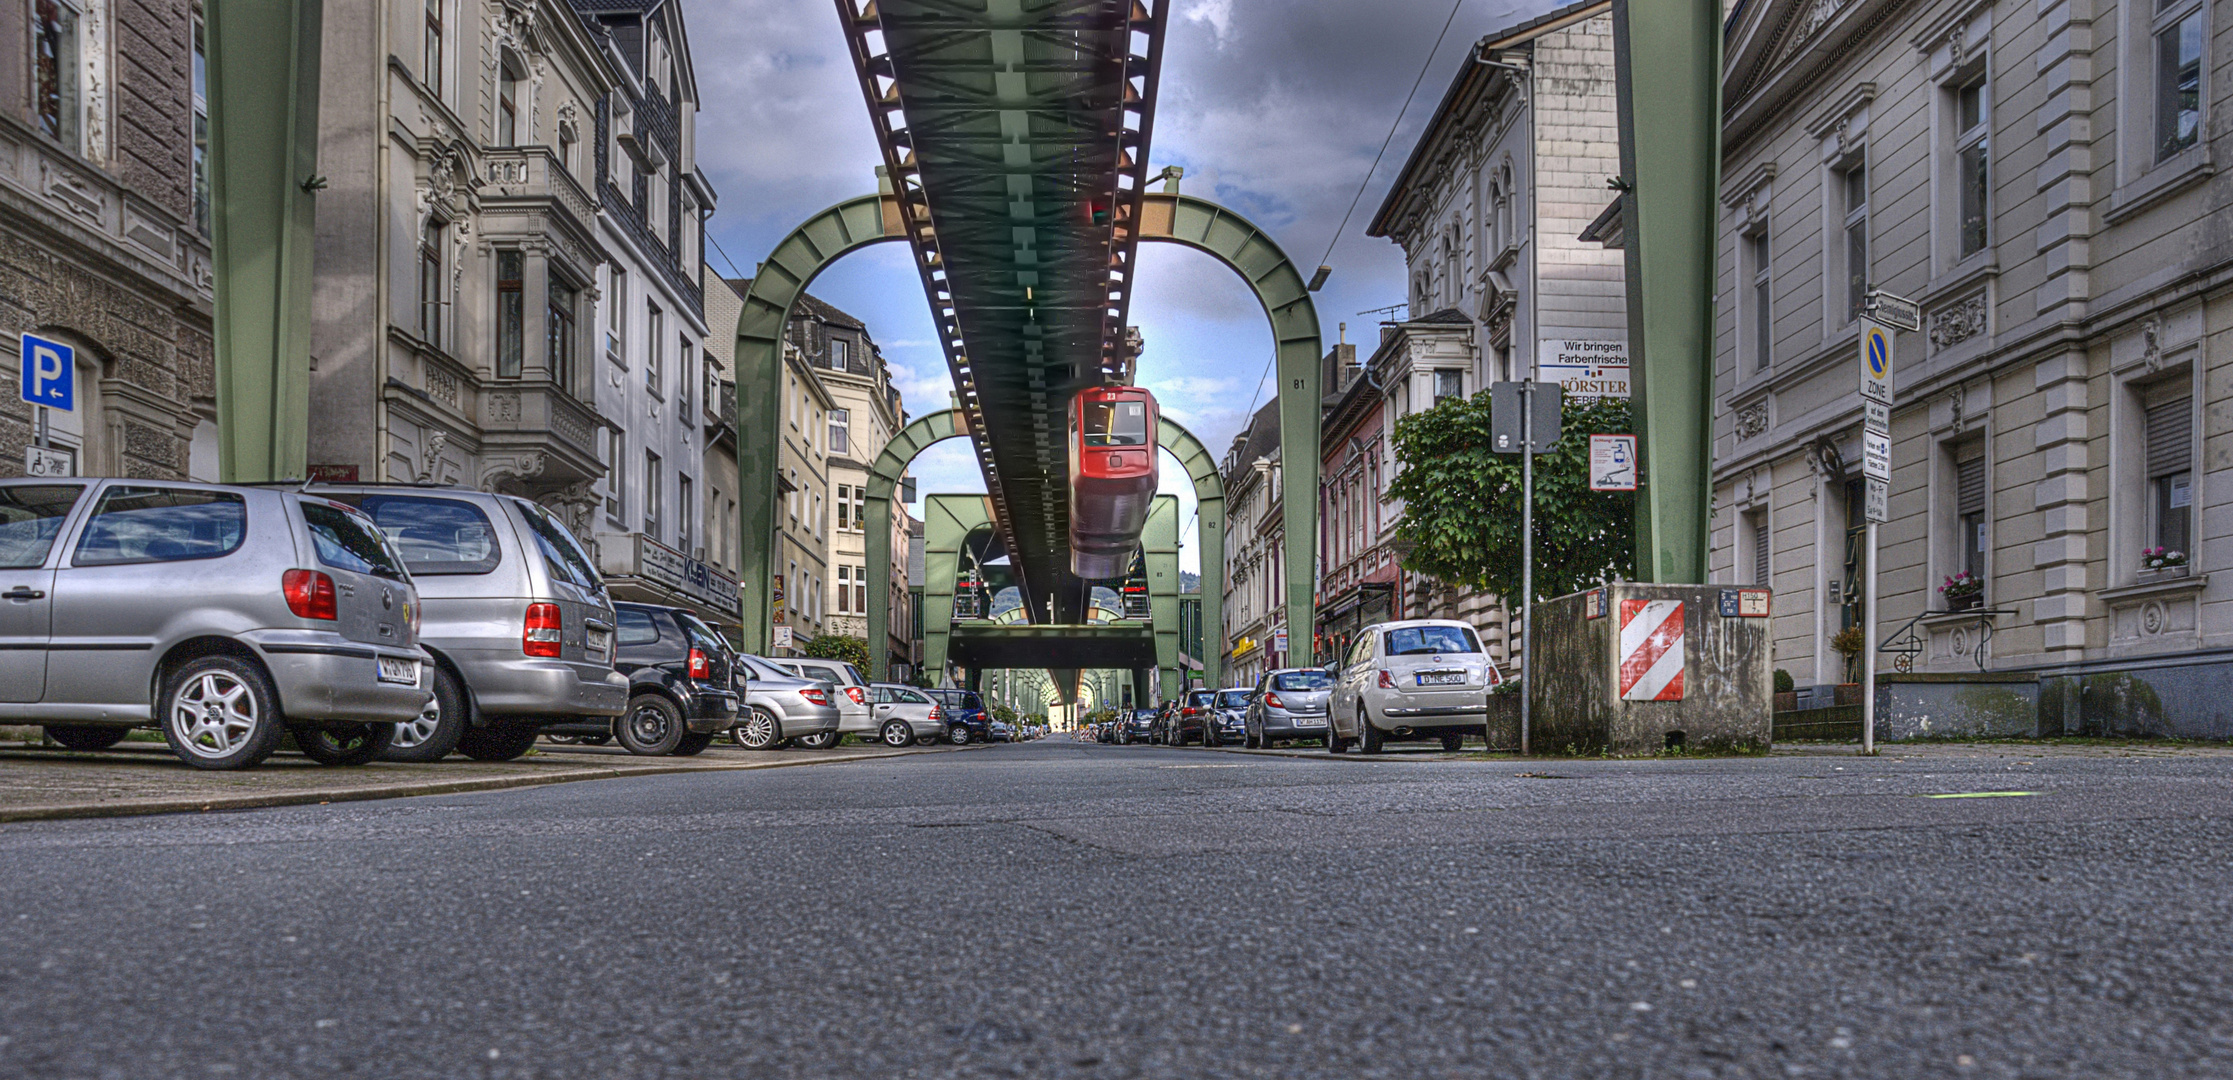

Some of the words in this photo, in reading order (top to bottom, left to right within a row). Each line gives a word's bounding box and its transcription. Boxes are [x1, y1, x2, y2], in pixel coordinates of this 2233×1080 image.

[1564, 342, 1582, 351] Wir
[1583, 341, 1622, 353] bringen
[1558, 353, 1628, 365] Farbenfrische
[33, 344, 63, 397] P
[1293, 378, 1305, 390] 81
[1560, 377, 1628, 394] FÖRSTER
[1867, 380, 1886, 399] ZONE
[1107, 392, 1116, 400] 23
[1208, 521, 1216, 529] 82
